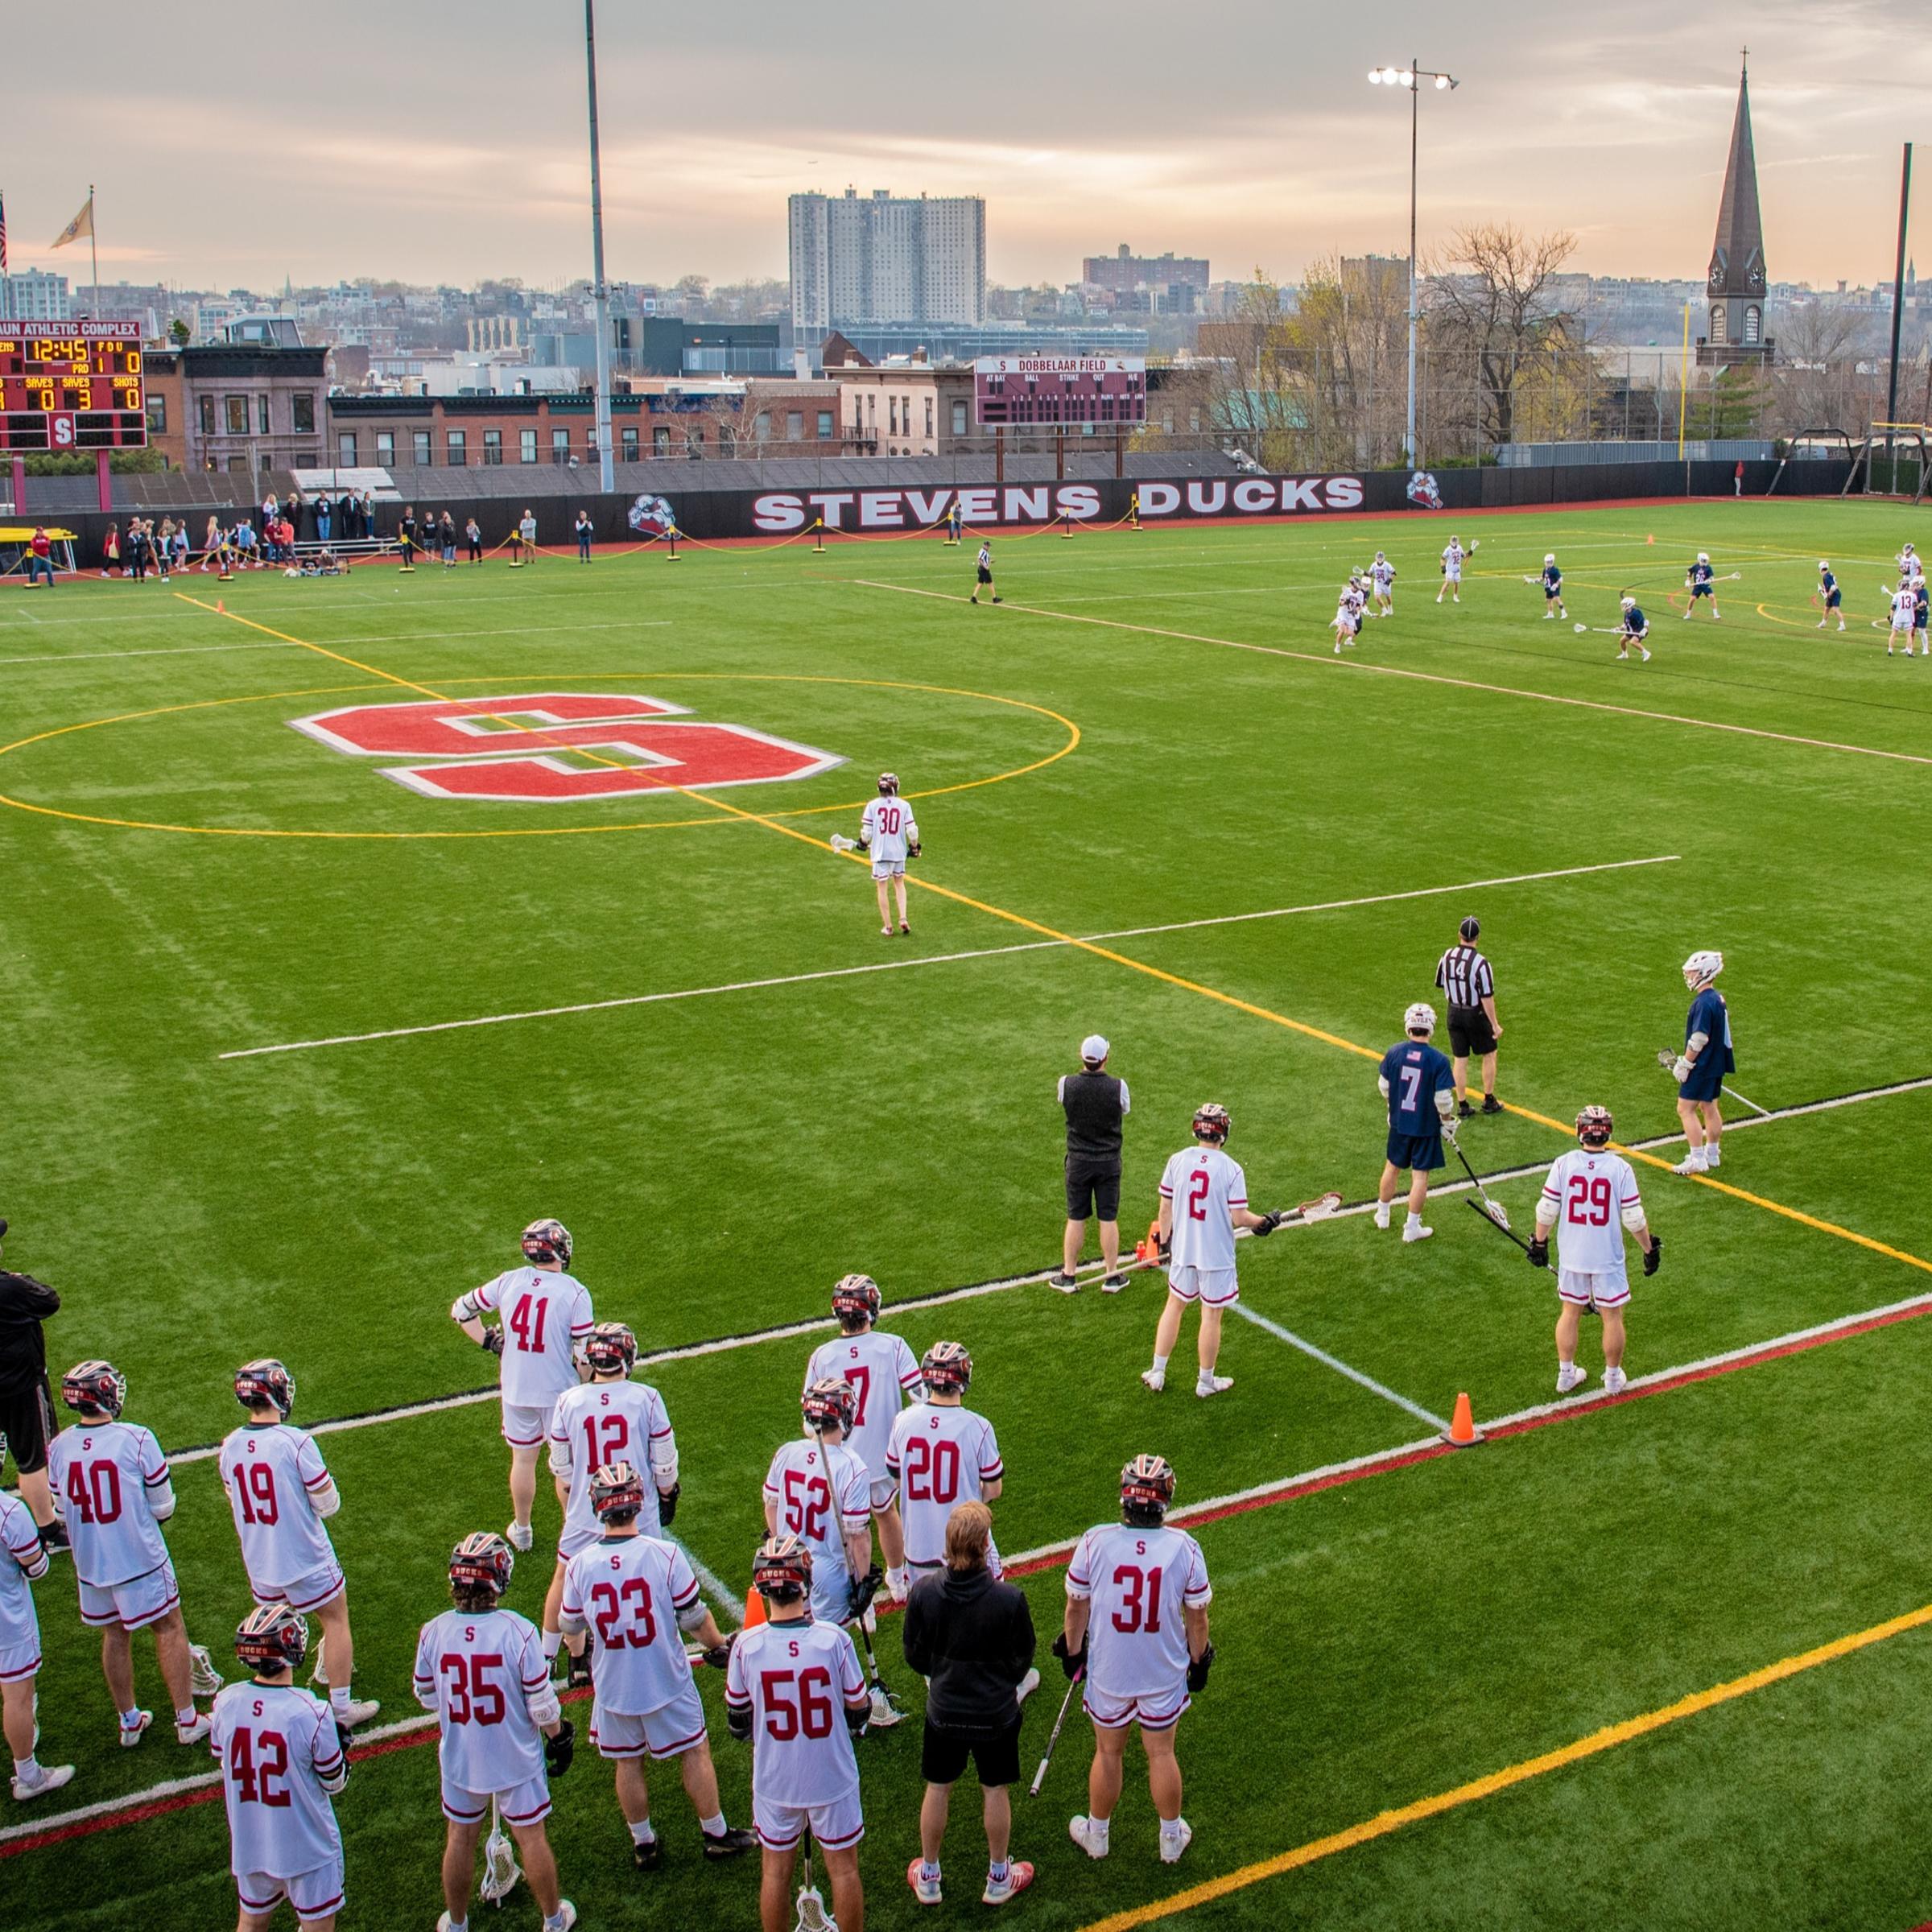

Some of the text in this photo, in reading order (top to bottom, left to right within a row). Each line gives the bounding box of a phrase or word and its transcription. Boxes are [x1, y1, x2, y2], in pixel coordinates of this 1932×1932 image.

[24, 323, 78, 335] ATHLETIC
[81, 323, 136, 335] COMPLEX
[34, 339, 87, 361] 12:45
[72, 364, 89, 374] PRD
[126, 352, 140, 374] 0
[1000, 361, 1006, 371] S
[1019, 361, 1106, 370] DOBBELAAR FIELD
[26, 378, 53, 387] SAVES
[62, 378, 90, 387] SAVES
[114, 378, 138, 387] SHOTS
[1025, 374, 1040, 382] BALL
[1059, 374, 1080, 382] STRIKE
[41, 390, 55, 411] 0
[79, 390, 91, 411] 3
[126, 389, 139, 410] 0
[55, 418, 72, 444] S
[753, 477, 1364, 531] STEVENS DUCKS
[1901, 596, 1911, 609] 13
[878, 807, 900, 835] 30
[1449, 959, 1465, 980] 14
[1401, 1067, 1421, 1112] 7
[1200, 1154, 1208, 1164] S
[1587, 1160, 1595, 1170] S
[1189, 1170, 1209, 1221] 2
[1568, 1175, 1611, 1226] 29
[533, 1277, 542, 1287] S
[510, 1294, 548, 1352] 41
[849, 1346, 859, 1360] S
[601, 1393, 609, 1406] S
[843, 1365, 870, 1426] 7
[930, 1416, 940, 1430] S
[83, 1437, 92, 1451] S
[247, 1439, 256, 1454] S
[584, 1414, 629, 1474] 12
[807, 1451, 817, 1465] S
[906, 1436, 960, 1504] 20
[68, 1459, 122, 1523] 40
[233, 1462, 279, 1525] 19
[784, 1469, 831, 1540] 52
[1136, 1539, 1146, 1556] S
[609, 1554, 621, 1571] S
[762, 1570, 791, 1579] DUCKS
[1112, 1564, 1162, 1632] 31
[592, 1577, 656, 1649] 23
[464, 1625, 476, 1643] S
[241, 1646, 268, 1655] DUCKS
[788, 1640, 800, 1658] S
[440, 1653, 506, 1724] 35
[253, 1699, 264, 1718] S
[760, 1666, 832, 1740] 56
[231, 1726, 290, 1805] 42
